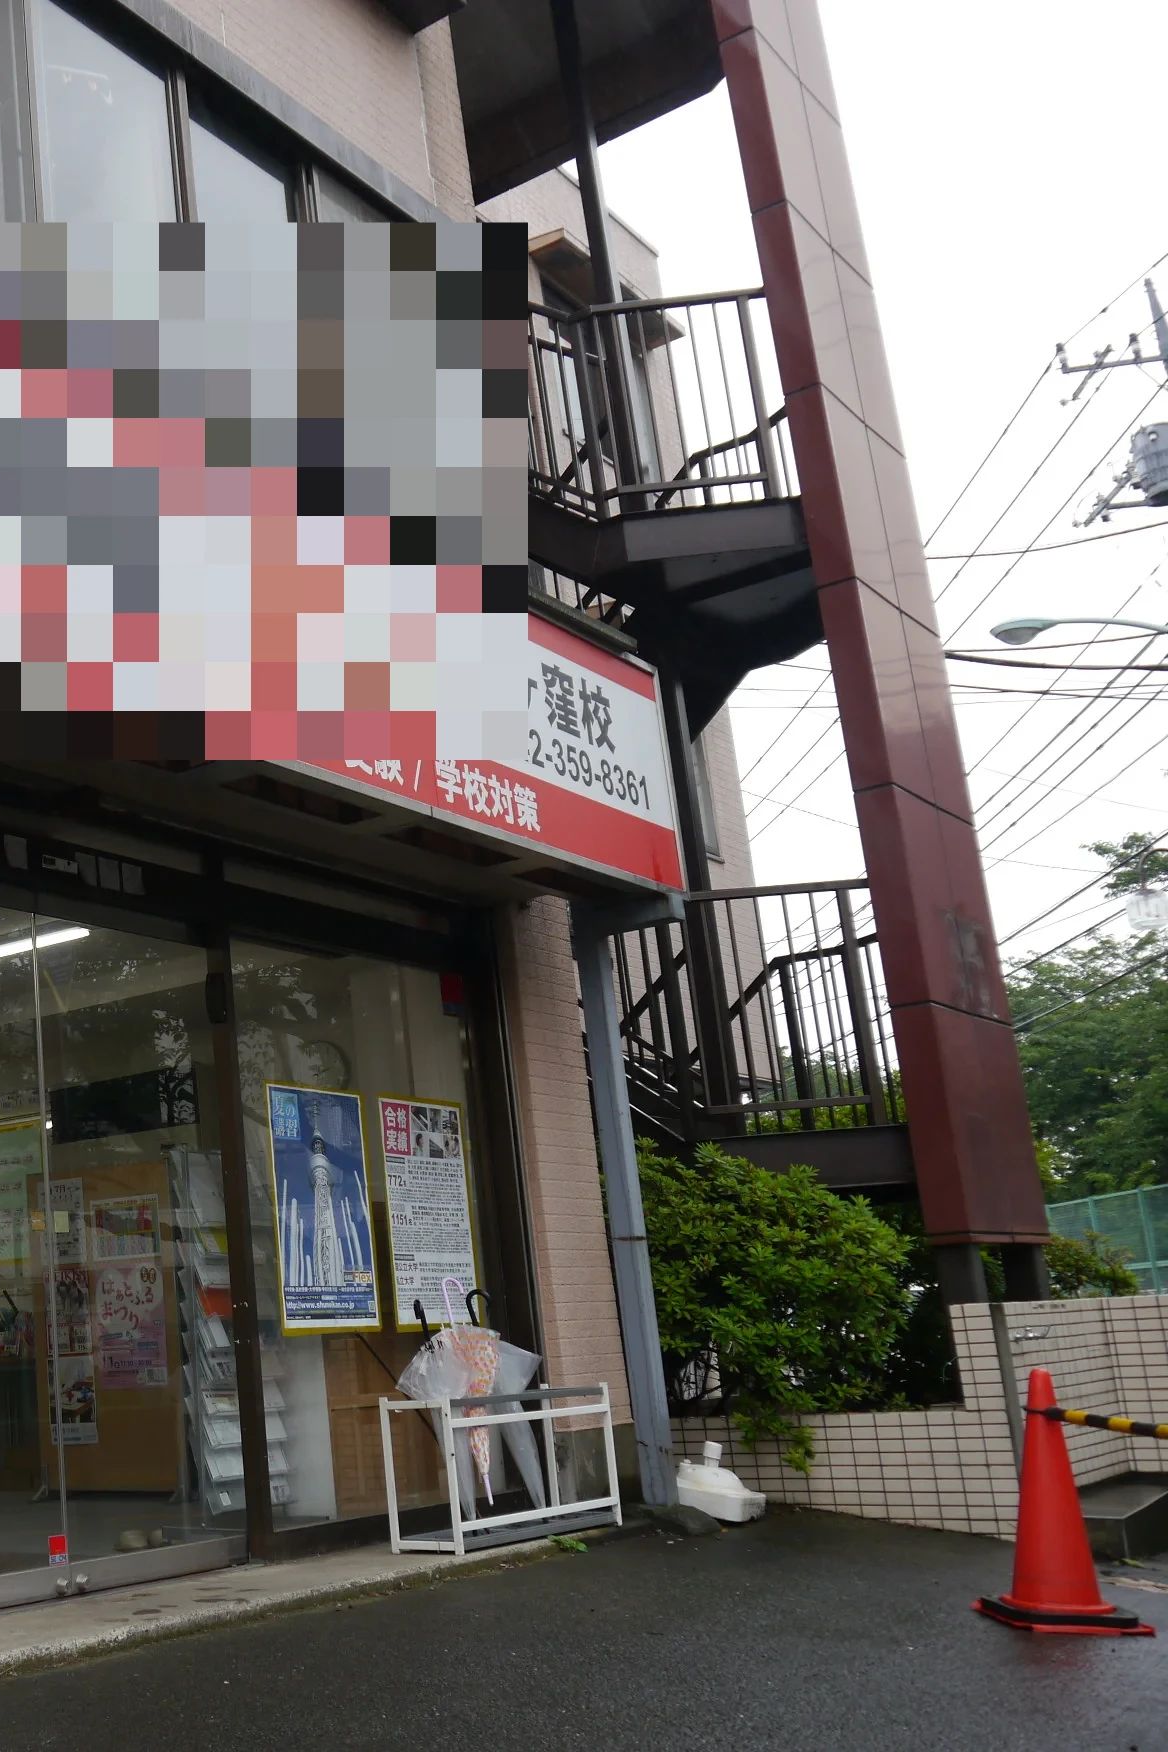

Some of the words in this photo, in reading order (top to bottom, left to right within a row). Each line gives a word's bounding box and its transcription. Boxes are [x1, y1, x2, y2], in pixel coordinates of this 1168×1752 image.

[528, 729, 650, 810] 2-359-8361
[385, 1106, 407, 1128] 合格
[386, 1130, 408, 1152] 実績
[353, 1272, 371, 1283] Flex
